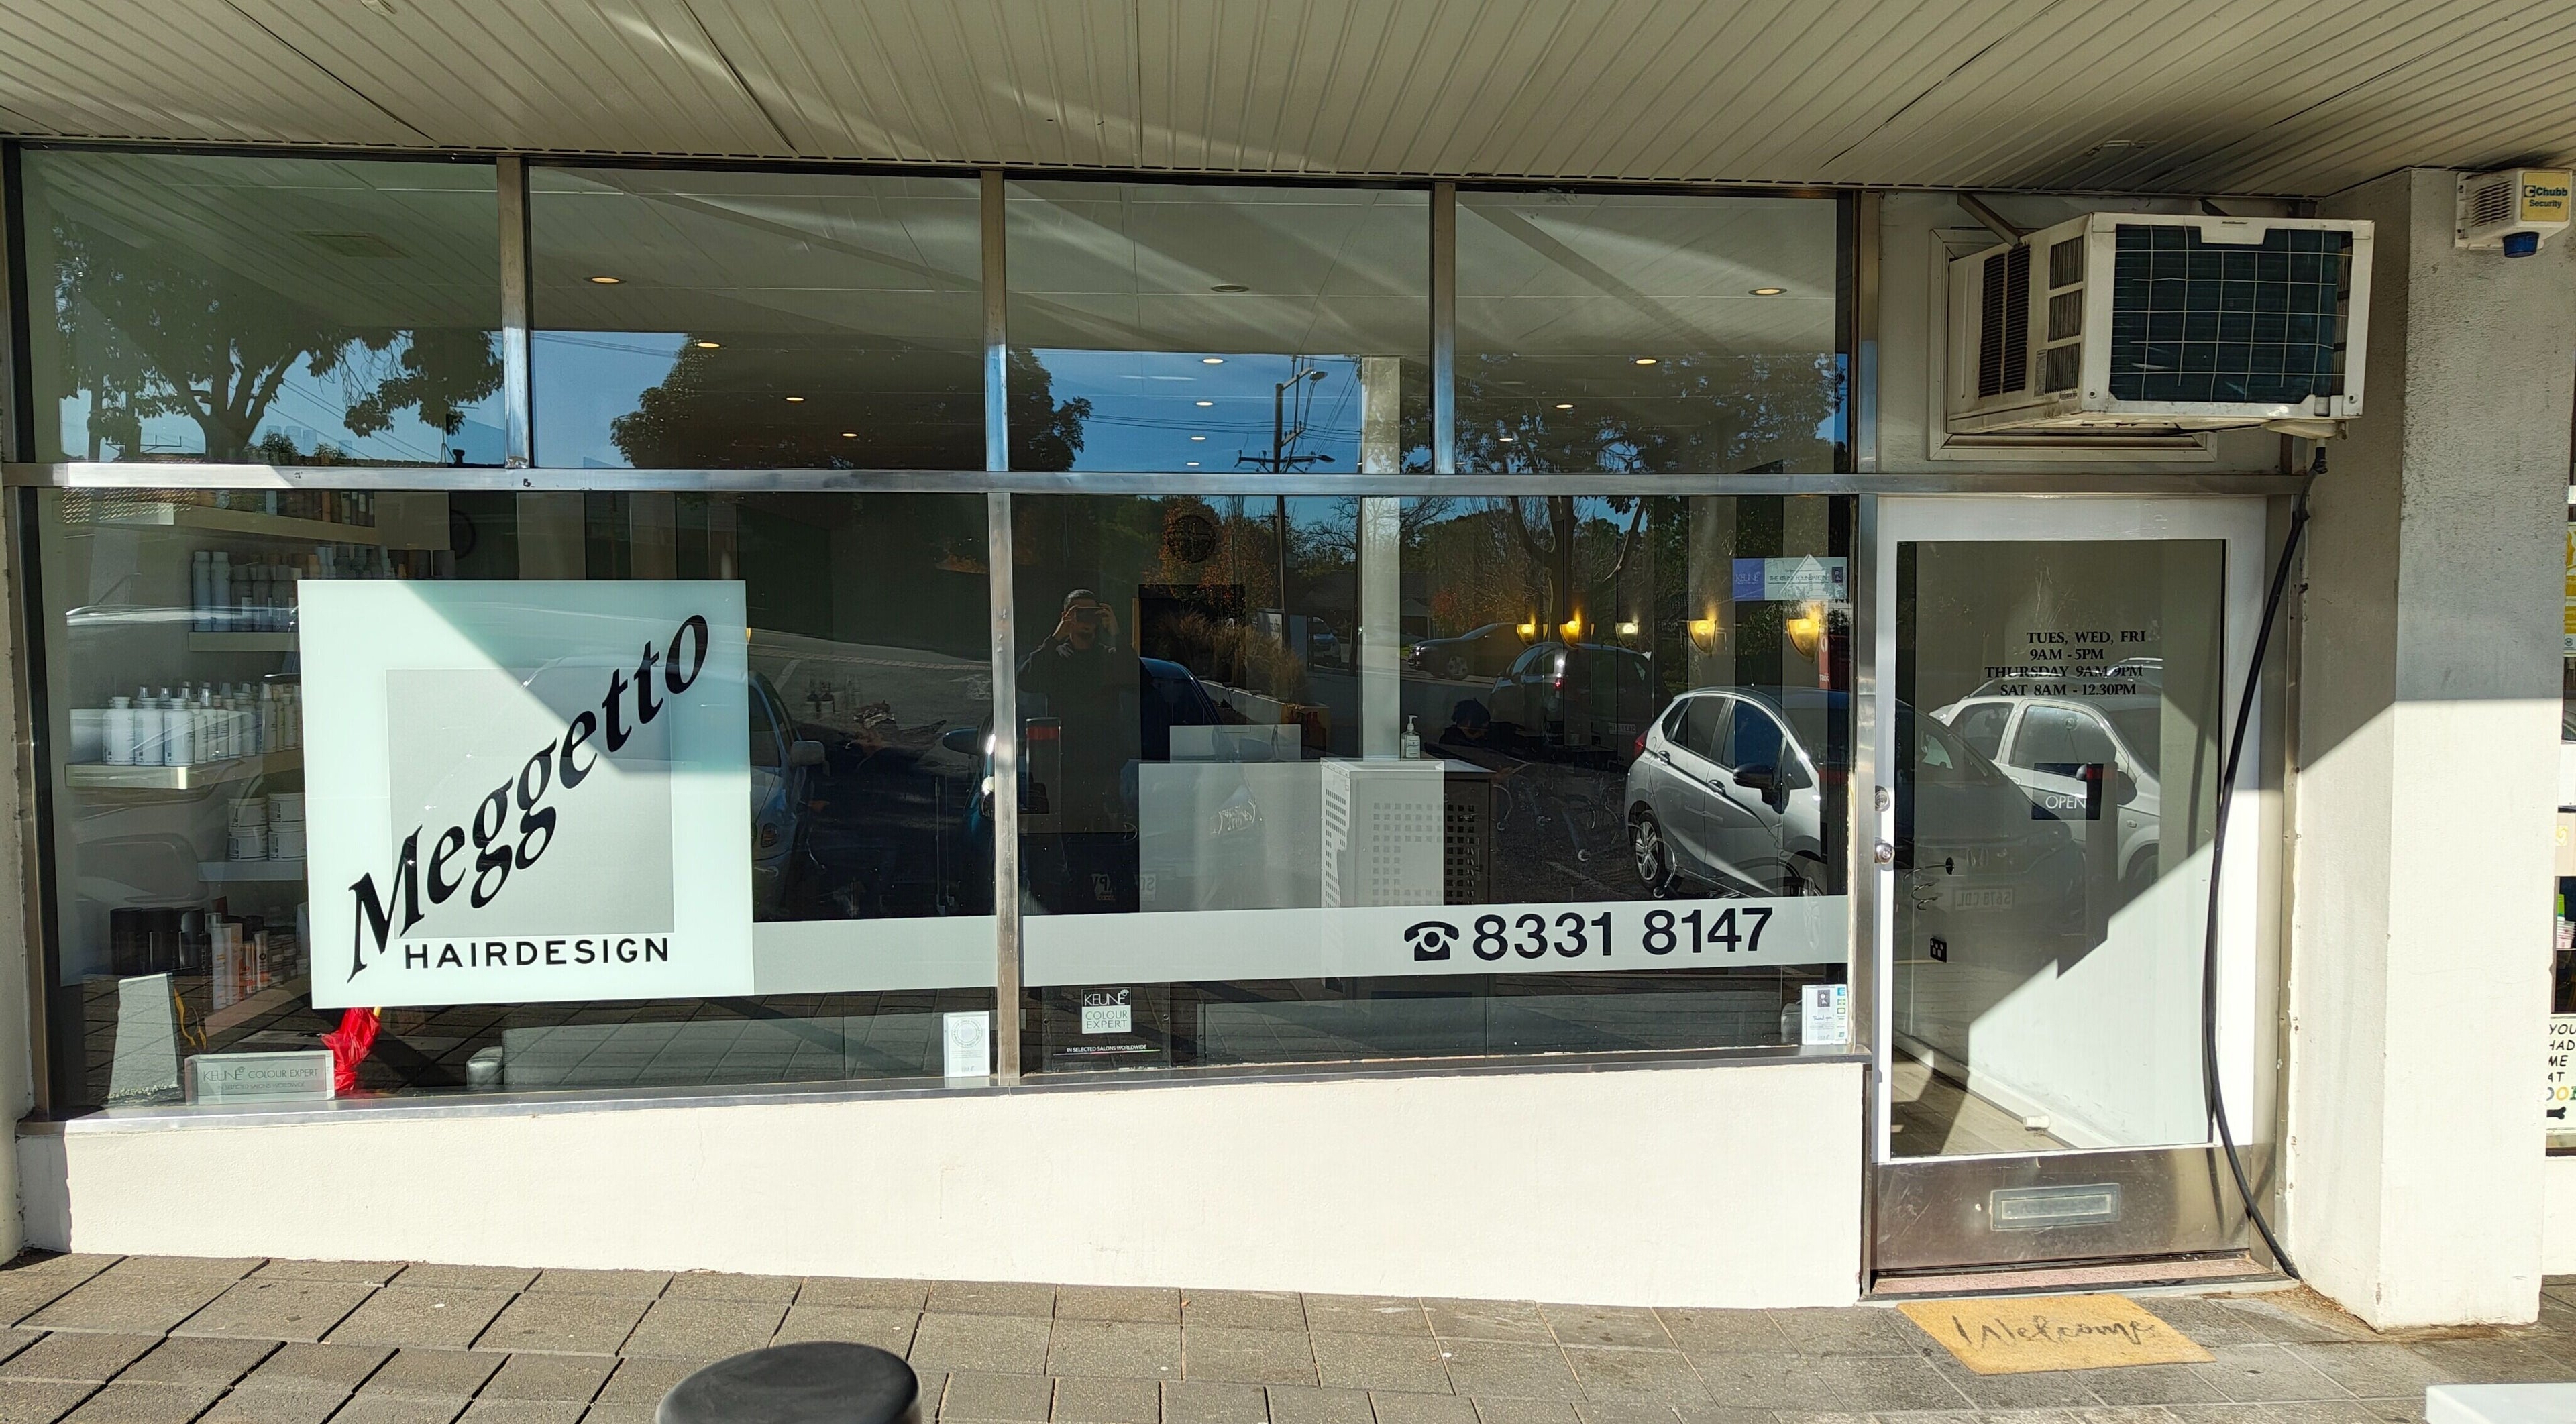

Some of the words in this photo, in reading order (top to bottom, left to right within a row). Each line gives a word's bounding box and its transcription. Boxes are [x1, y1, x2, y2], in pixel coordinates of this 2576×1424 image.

[2536, 186, 2568, 197] Chubb
[2529, 199, 2562, 209] Security
[2026, 631, 2068, 645] TUES,
[2074, 631, 2114, 645] WED,
[2120, 631, 2146, 642] FRI
[2029, 649, 2063, 661] 9AM
[2074, 648, 2104, 660] 5PM
[1984, 665, 2070, 678] THURSDAY
[2000, 684, 2028, 696] SAT
[2033, 683, 2067, 696] 8AM
[2082, 683, 2137, 696] 12.30PM
[347, 614, 709, 984] Meggetto
[2045, 795, 2086, 809] OPEN
[1472, 911, 1611, 961] 8331
[1642, 906, 1774, 956] 8147
[405, 937, 669, 970] HAIRDESIGN
[1084, 993, 1126, 1006] KEUNE
[1085, 1010, 1128, 1020] COLOUR
[1086, 1020, 1128, 1029] EXPERT
[2548, 1055, 2568, 1066] ME
[203, 1069, 242, 1082] KEUNE
[248, 1069, 287, 1079] COLOUR
[290, 1068, 318, 1078] EXPERT
[1951, 1314, 2152, 1347] Welcome
